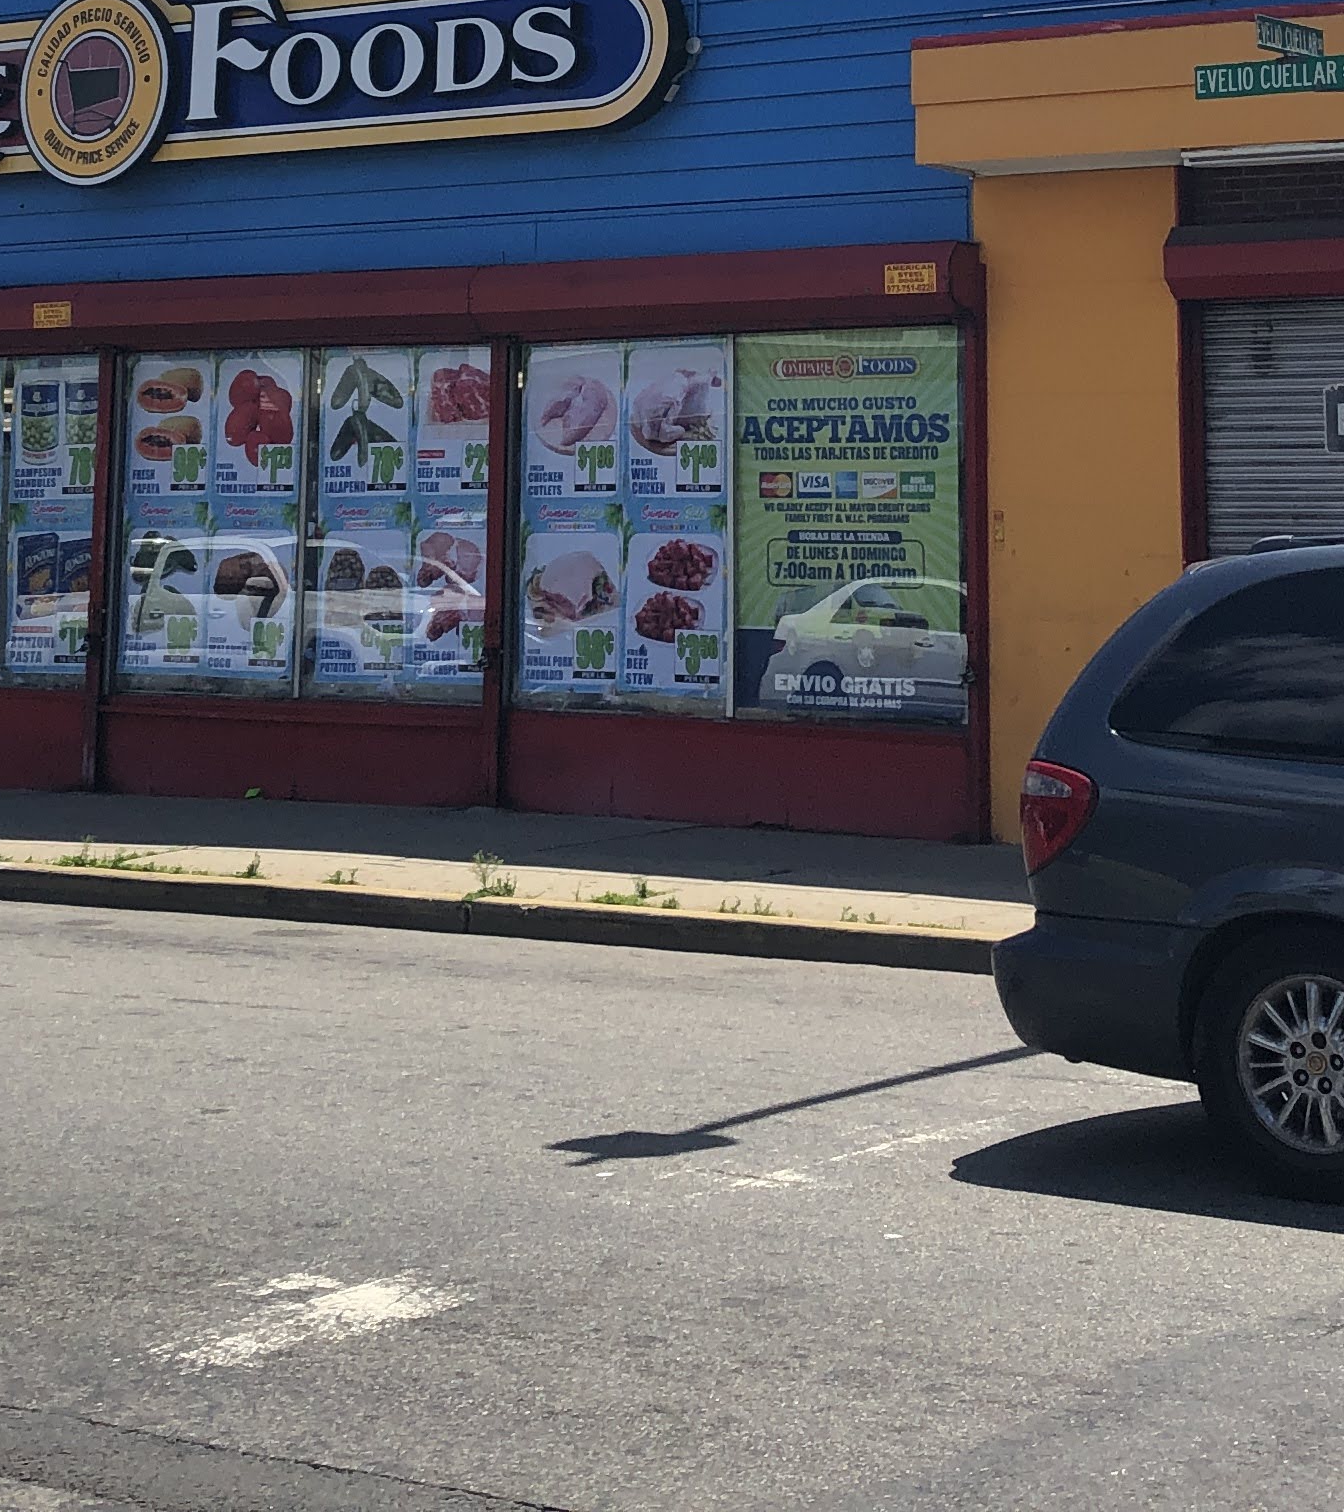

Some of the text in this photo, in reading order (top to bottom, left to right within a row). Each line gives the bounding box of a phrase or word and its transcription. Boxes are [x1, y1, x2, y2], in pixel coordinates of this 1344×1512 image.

[38, 7, 151, 78] CALIDAD PRECIO SERVICIO
[1196, 65, 1254, 94] EVELIO
[1260, 61, 1337, 90] CUELLAR
[44, 117, 140, 165] QUALITY PRICE SERVICE
[768, 396, 917, 411] CON MUCHO GUSTO
[740, 413, 950, 444] ACEPTAMOS
[754, 445, 939, 460] TODAS LAS TARJETAS DE CREDITO
[631, 458, 652, 466] FRESH
[15, 467, 62, 477] CAMPESINO
[132, 469, 155, 480] FRESH
[216, 472, 237, 481] PLUM
[325, 466, 351, 478] FRESH
[417, 467, 461, 478] BEEF CHUCK
[528, 472, 563, 483] CHICKEN
[631, 468, 658, 480] WHOLE
[14, 478, 56, 488] GANDULES
[417, 481, 440, 492] STEAK
[800, 476, 830, 489] VISA
[863, 477, 895, 486] DISCOVER
[132, 483, 160, 494] PAPAYA
[216, 483, 257, 493] TOMATOES
[528, 485, 562, 496] CUTLETS
[632, 481, 665, 494] CHICKEN
[14, 489, 45, 498] VERDES
[764, 503, 775, 512] WE
[777, 503, 803, 512] GLADLY
[805, 503, 833, 512] ACCEPT
[835, 503, 848, 512] ALL
[878, 502, 904, 512] CREDIT
[906, 503, 931, 512] CARDS
[785, 514, 810, 523] FAMILY
[813, 514, 834, 523] FIRST
[798, 532, 890, 541] HORAS DE LA TIENDA
[787, 547, 907, 561] DE LUNES A DOMINGO
[774, 562, 917, 582] 7:00am A 10:00pm
[9, 651, 42, 663] PASTA
[321, 650, 352, 660] EASTERN
[526, 655, 573, 667] WHOLE PORK
[626, 657, 649, 670] BEEF
[320, 663, 356, 673] POTATOES
[525, 670, 564, 681] SHOULDER
[625, 673, 654, 686] STEW
[774, 674, 917, 697] ENVIO GRATIS
